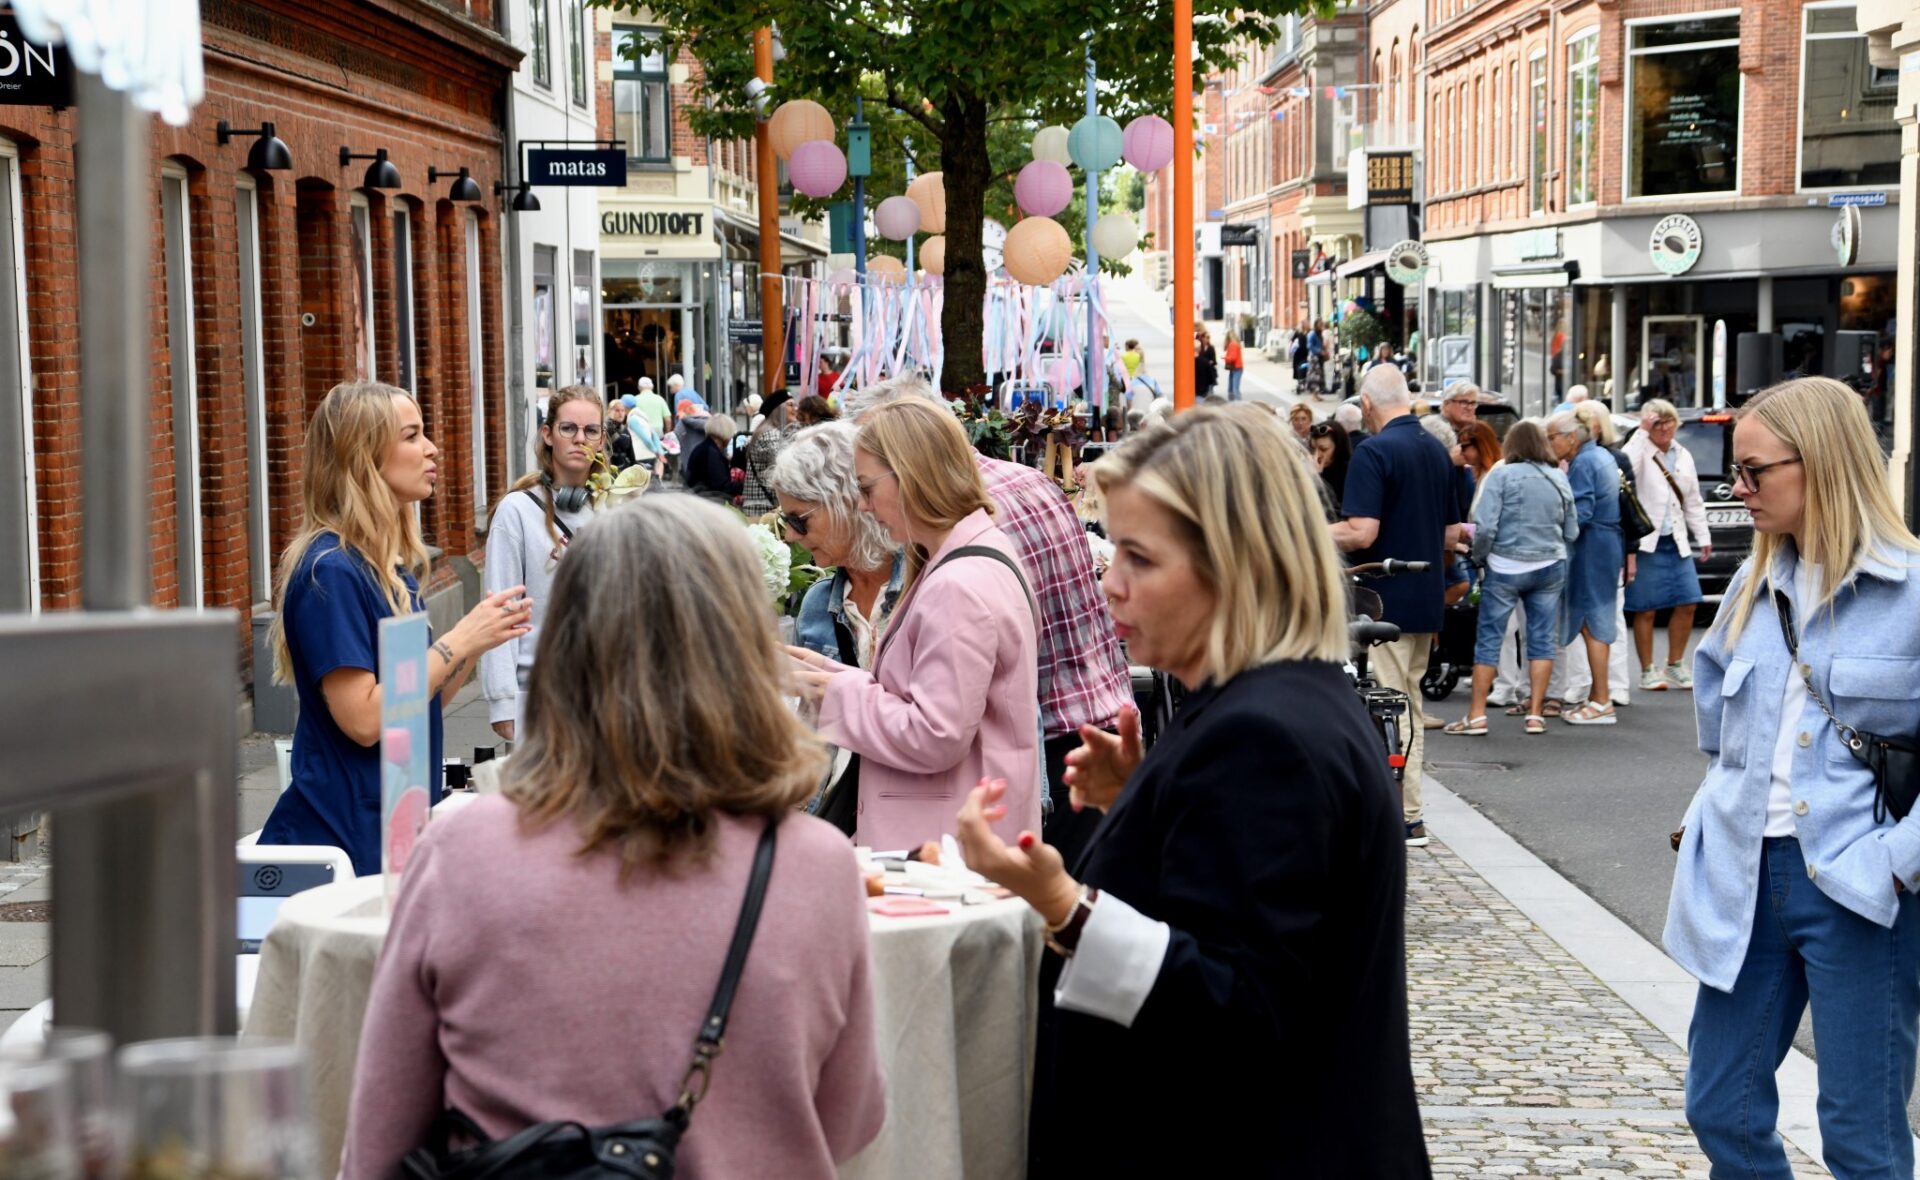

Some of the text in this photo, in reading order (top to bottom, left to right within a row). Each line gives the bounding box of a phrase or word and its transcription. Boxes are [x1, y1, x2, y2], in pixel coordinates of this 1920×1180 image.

[549, 160, 606, 176] matas
[601, 211, 703, 235] GUNDTOFT
[1717, 511, 1732, 523] 27
[1735, 511, 1750, 522] 22
